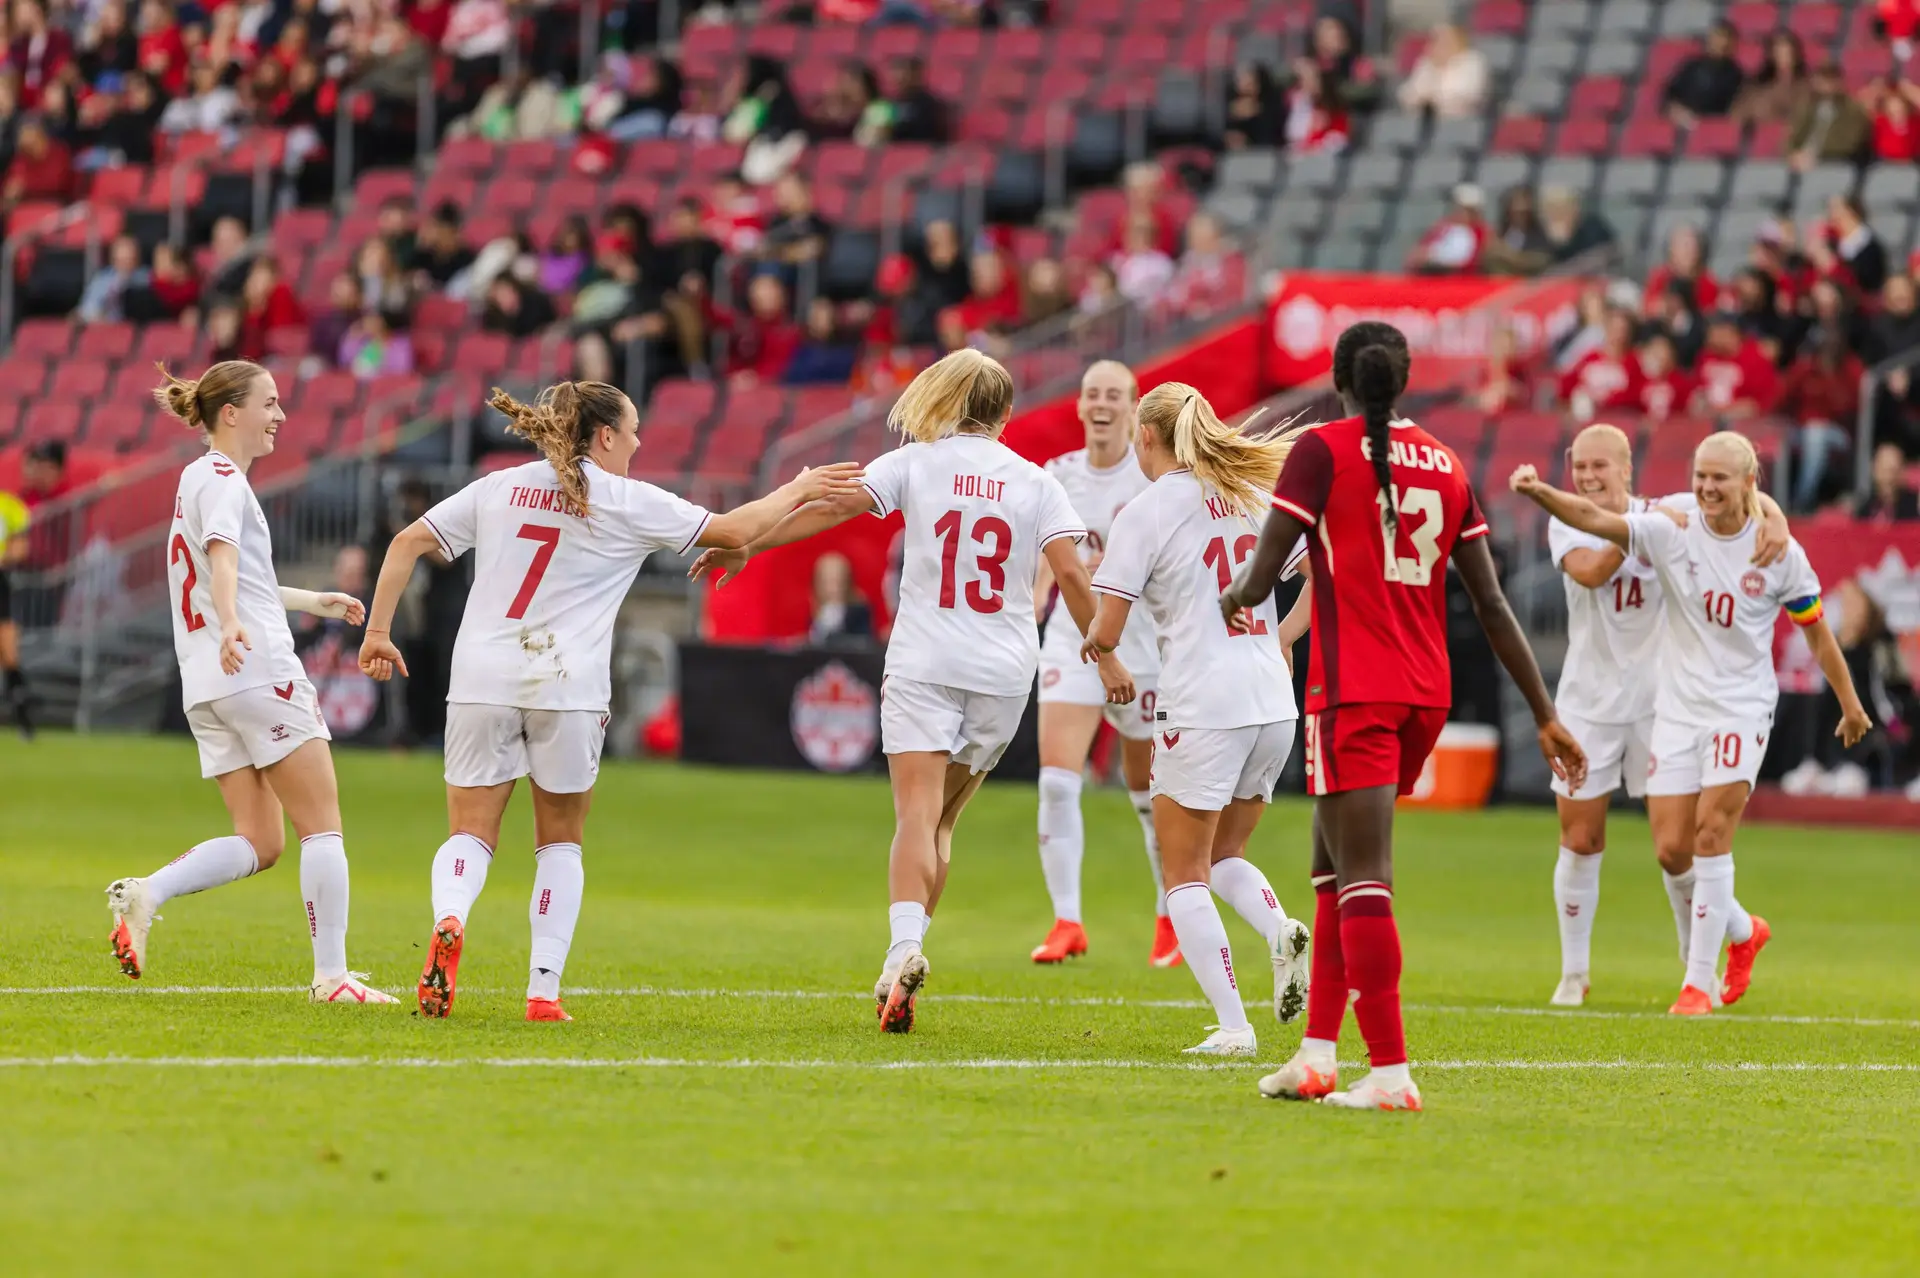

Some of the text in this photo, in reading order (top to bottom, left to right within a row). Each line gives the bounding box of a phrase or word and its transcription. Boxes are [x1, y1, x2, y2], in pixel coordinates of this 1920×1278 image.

[954, 474, 1005, 502] HOLDT
[1376, 484, 1443, 586] 13
[171, 533, 206, 633] 2
[505, 523, 561, 620] 7
[934, 509, 1012, 614] 13
[1612, 576, 1645, 612] 14
[1703, 589, 1735, 628] 10
[1713, 733, 1742, 769] 10
[1220, 947, 1238, 990] DANMARK
